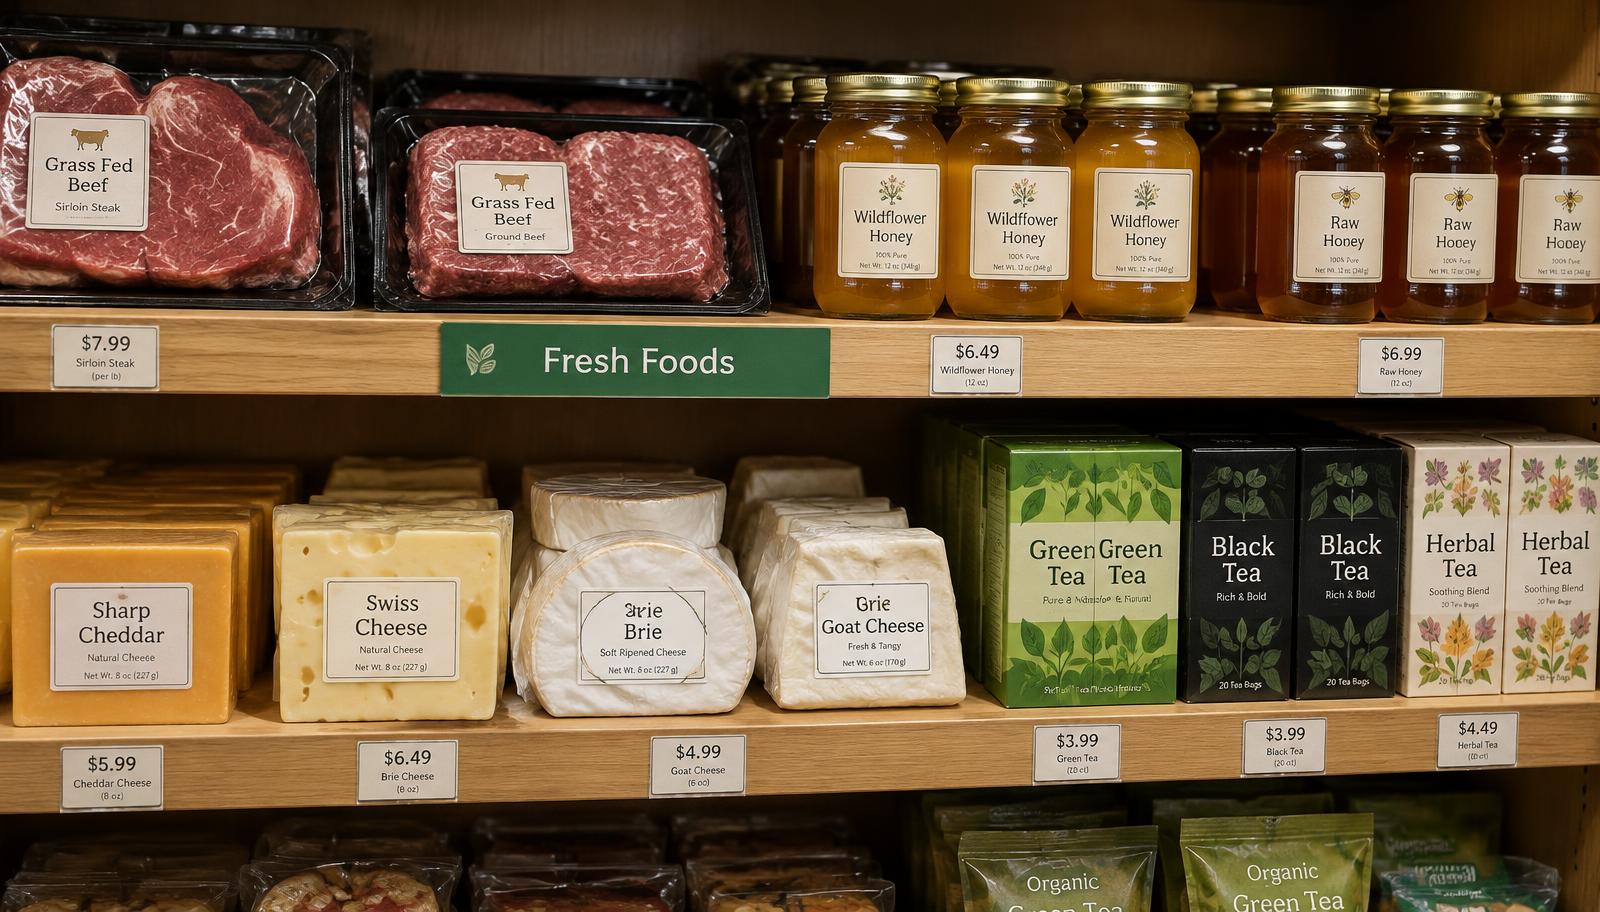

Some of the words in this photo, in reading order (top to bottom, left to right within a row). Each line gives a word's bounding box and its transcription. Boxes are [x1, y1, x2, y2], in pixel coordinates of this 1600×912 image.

[46, 157, 95, 172] Grass
[102, 158, 132, 172] Fed
[68, 177, 108, 192] Beef
[55, 202, 88, 211] Sirloin
[91, 203, 121, 213] Steak
[472, 197, 519, 208] Grass
[525, 197, 555, 209] Fed
[495, 213, 531, 225] Beef
[854, 210, 926, 224] Wildflower
[1111, 215, 1179, 228] Wildflower
[1332, 216, 1359, 229] Raw
[1444, 218, 1472, 230] Raw
[1554, 219, 1581, 231] Raw
[485, 232, 521, 241] Ground
[524, 233, 546, 241] Beef
[870, 230, 912, 246] Honey
[1003, 231, 1045, 247] Honey
[1126, 233, 1166, 249] Honey
[82, 335, 130, 351] $7.99
[956, 343, 999, 359] $6.49
[1382, 346, 1421, 361] $6.99
[76, 358, 106, 368] Sirloin
[109, 359, 135, 368] Steak
[545, 347, 628, 373] Fresh
[643, 348, 734, 374] Foods
[91, 372, 109, 382] (per
[111, 373, 122, 382] lb)
[940, 366, 985, 375] Wildflower
[988, 366, 1015, 376] Honey
[1399, 368, 1422, 377] Honey
[965, 379, 975, 387] (12
[1212, 535, 1275, 556] Black
[1320, 534, 1381, 554] Black
[1426, 533, 1495, 552] Herbal
[1522, 531, 1589, 550] Herbal
[1030, 540, 1095, 559] Green
[1100, 539, 1162, 558] Green
[1223, 563, 1261, 582] Tea
[1331, 561, 1369, 580] Tea
[1443, 559, 1477, 577] Tea
[1538, 557, 1572, 575] Tea
[1048, 566, 1085, 585] Tea
[1108, 566, 1146, 584] Tea
[1325, 590, 1344, 600] Rich
[1347, 590, 1353, 599] &
[1355, 590, 1376, 599] Bold
[1429, 587, 1465, 597] Soothing
[1467, 586, 1490, 595] Blend
[1524, 585, 1559, 594] Soothing
[1561, 583, 1584, 592] Blend
[367, 595, 418, 611] Swiss
[1216, 592, 1236, 602] Rich
[1238, 593, 1244, 601] &
[1247, 592, 1267, 601] Bold
[94, 602, 150, 622] Sharp
[356, 618, 427, 635] Cheese
[625, 623, 661, 639] Brie
[822, 620, 861, 634] Goat
[866, 618, 924, 633] Cheese
[79, 626, 164, 643] Cheddar
[360, 646, 390, 654] Natural
[393, 646, 424, 654] Cheese
[848, 642, 869, 650] Fresh
[879, 641, 902, 651] Tangy
[87, 654, 119, 662] Natural
[122, 654, 155, 662] Cheese
[600, 648, 617, 657] Soft
[620, 648, 654, 659] Ripened
[656, 648, 687, 656] Cheese
[402, 664, 418, 672] (227
[420, 664, 427, 672] g)
[84, 672, 98, 680] Net
[100, 672, 113, 680] Wt.
[1326, 678, 1337, 686] 20
[1338, 678, 1351, 686] Tea
[1352, 677, 1370, 687] Bags
[1219, 681, 1229, 690] 20
[1266, 727, 1305, 741] $3.99
[1459, 721, 1497, 735] $4.49
[1057, 733, 1098, 749] $3.99
[1458, 741, 1483, 749] Herbal
[385, 750, 431, 766] $6.49
[677, 744, 720, 760] $4.99
[1057, 754, 1082, 763] Green
[1084, 754, 1098, 762] Tea
[1266, 748, 1288, 756] Black
[1290, 747, 1304, 755] Tea
[89, 756, 136, 772] $5.99
[671, 767, 691, 775] Goat
[694, 766, 726, 775] Cheese
[381, 772, 399, 781] Brie
[401, 772, 434, 780] Cheese
[688, 779, 696, 787] (6
[73, 780, 114, 789] Cheddar
[117, 779, 152, 788] Cheese
[407, 785, 419, 793] oz)
[101, 792, 109, 801] (8
[111, 792, 124, 801] oz)
[1247, 862, 1319, 885] Organic
[1027, 873, 1100, 895] Organic
[1234, 895, 1299, 912] Green
[1304, 891, 1344, 910] Tea
